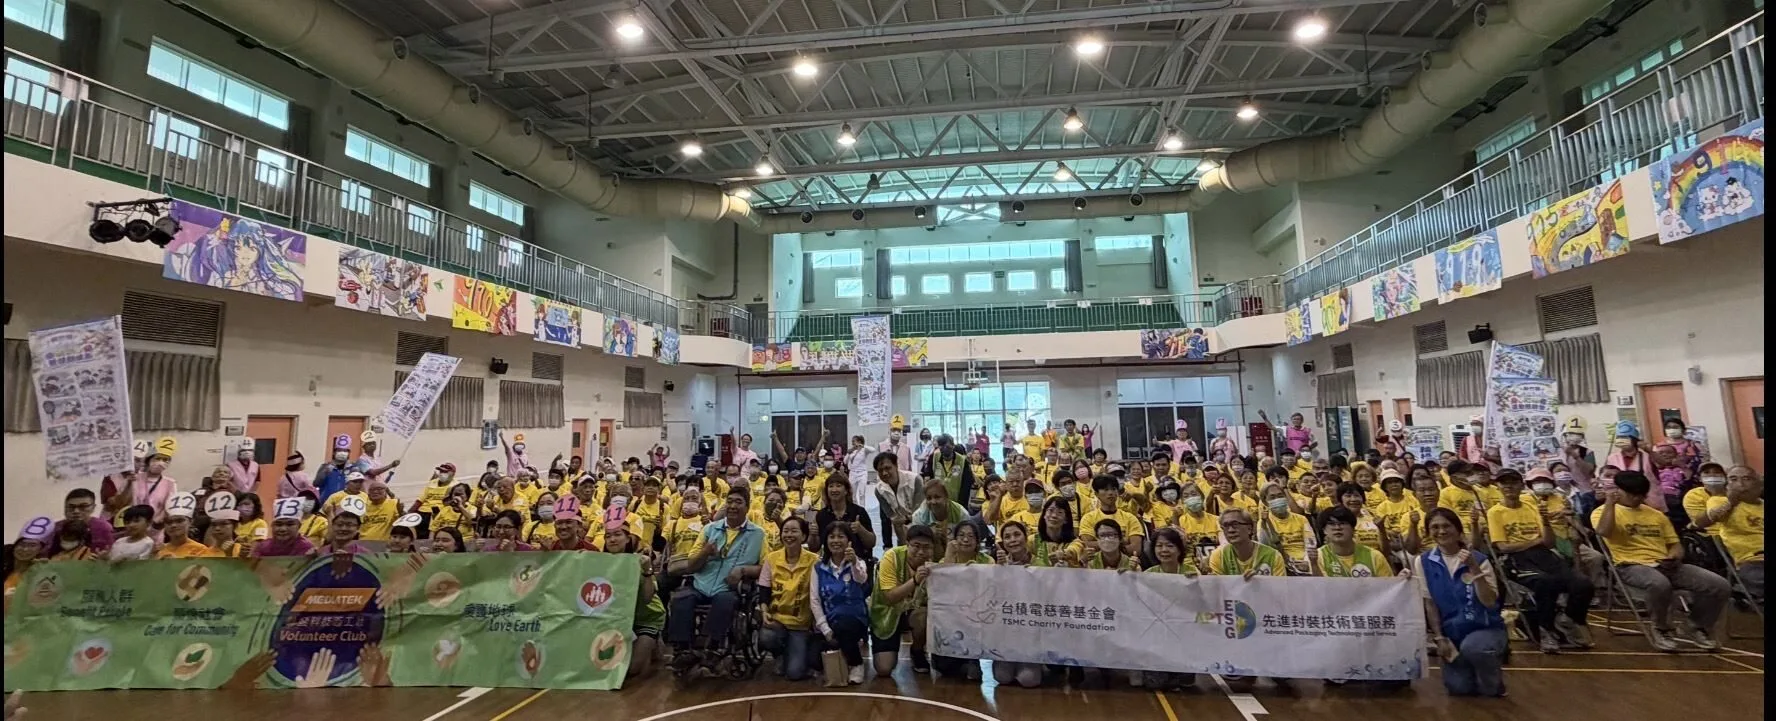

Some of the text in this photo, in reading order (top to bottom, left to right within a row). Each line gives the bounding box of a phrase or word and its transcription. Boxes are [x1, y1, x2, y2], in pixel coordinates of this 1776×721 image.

[1392, 421, 1399, 430] 3
[1570, 418, 1583, 429] 1
[337, 435, 348, 447] 8
[363, 431, 373, 440] 2
[134, 441, 146, 452] 4
[159, 439, 174, 451] 2
[168, 496, 194, 510] 12
[208, 494, 232, 513] 12
[274, 499, 300, 517] 13
[343, 497, 365, 511] 10
[555, 496, 576, 514] 11
[604, 506, 623, 524] 11
[25, 516, 50, 536] 8
[305, 595, 363, 605] MEDIATEK
[1002, 601, 1116, 621] 台積電慈善基金會
[490, 618, 541, 632] Love Earth
[1002, 618, 1116, 631] TSMC Charity Foundation
[1262, 614, 1396, 631] 先進封裝技術暨服務
[280, 630, 367, 641] Volunteer Club
